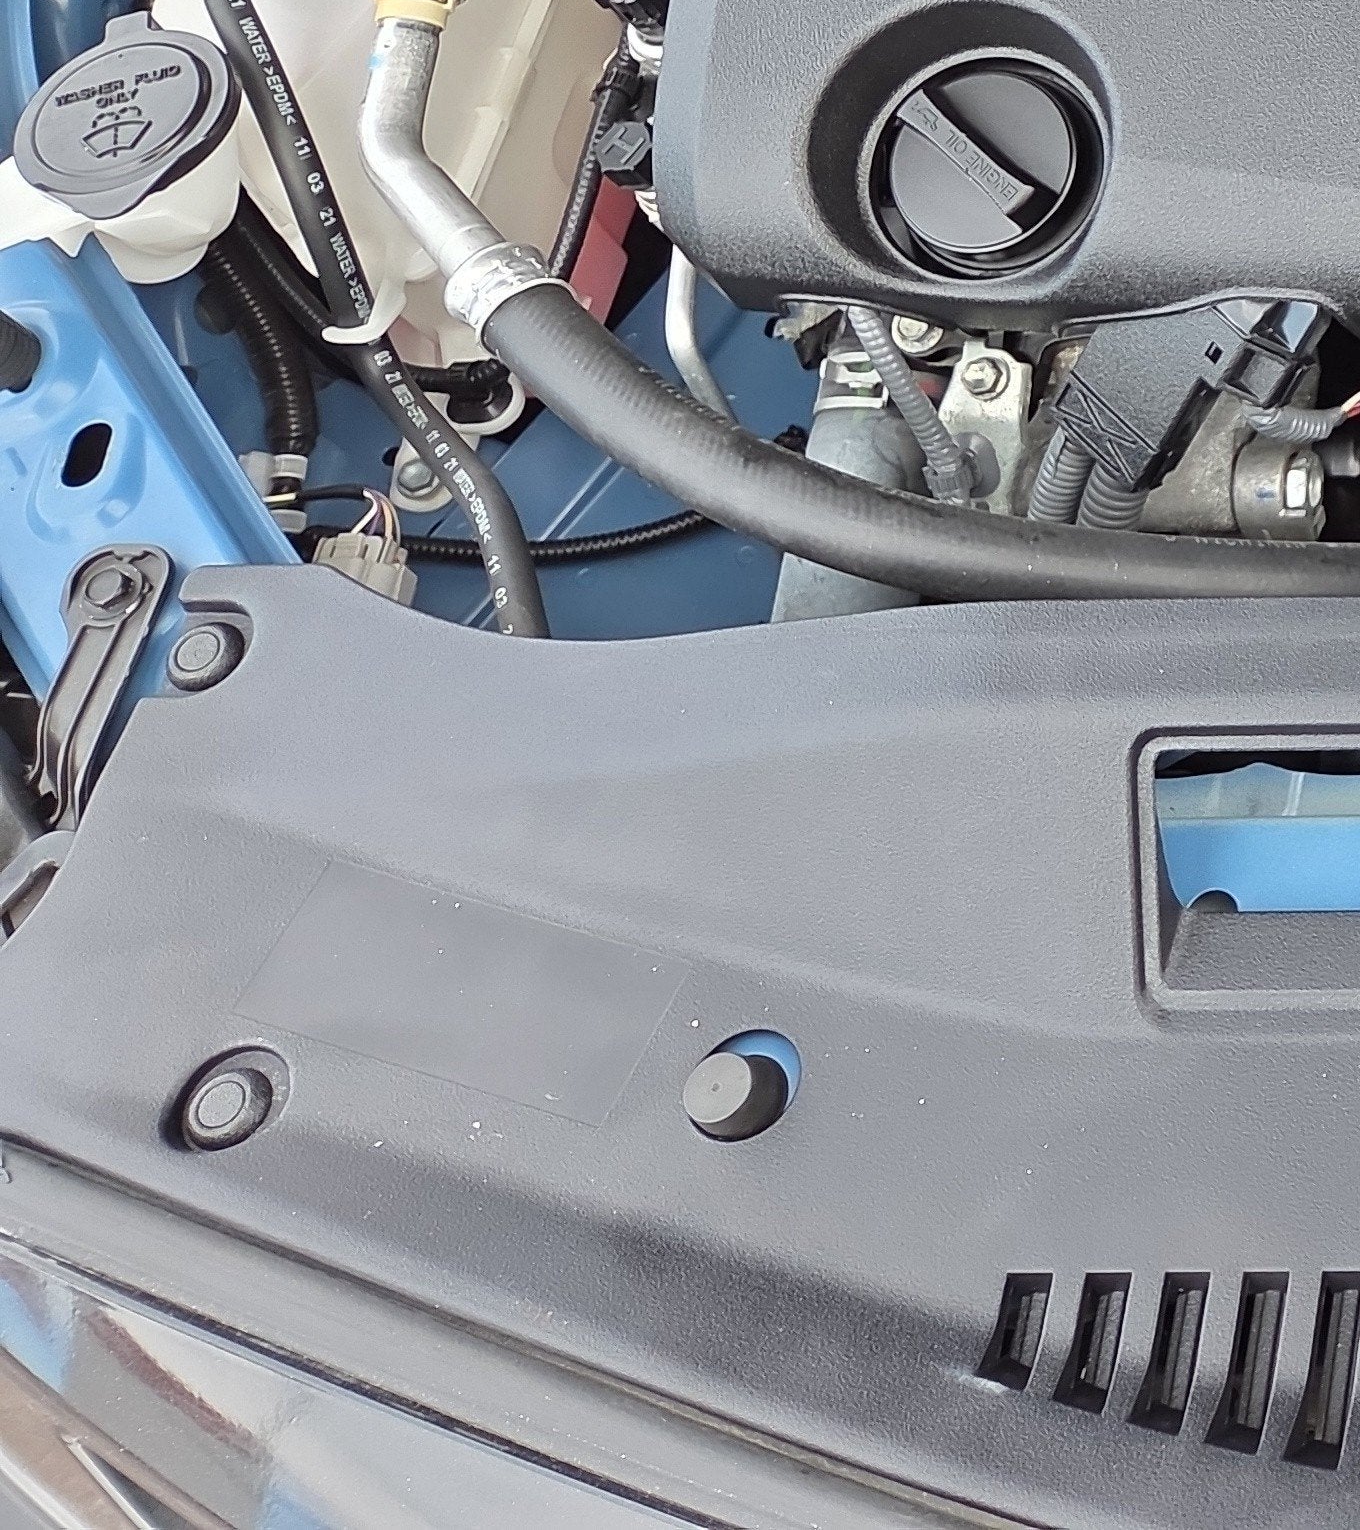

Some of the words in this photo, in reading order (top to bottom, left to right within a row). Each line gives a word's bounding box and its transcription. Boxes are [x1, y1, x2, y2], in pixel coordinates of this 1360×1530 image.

[55, 79, 126, 108] WASHER
[134, 64, 182, 86] FLUID
[95, 88, 140, 110] ONLY
[239, 16, 271, 65] WATER
[306, 171, 325, 195] 03
[319, 206, 337, 227] 21
[329, 232, 357, 278] WATER
[945, 130, 968, 155] OIL
[964, 149, 1018, 202] ENGINE
[486, 555, 502, 576] 11
[494, 586, 508, 609] 03
